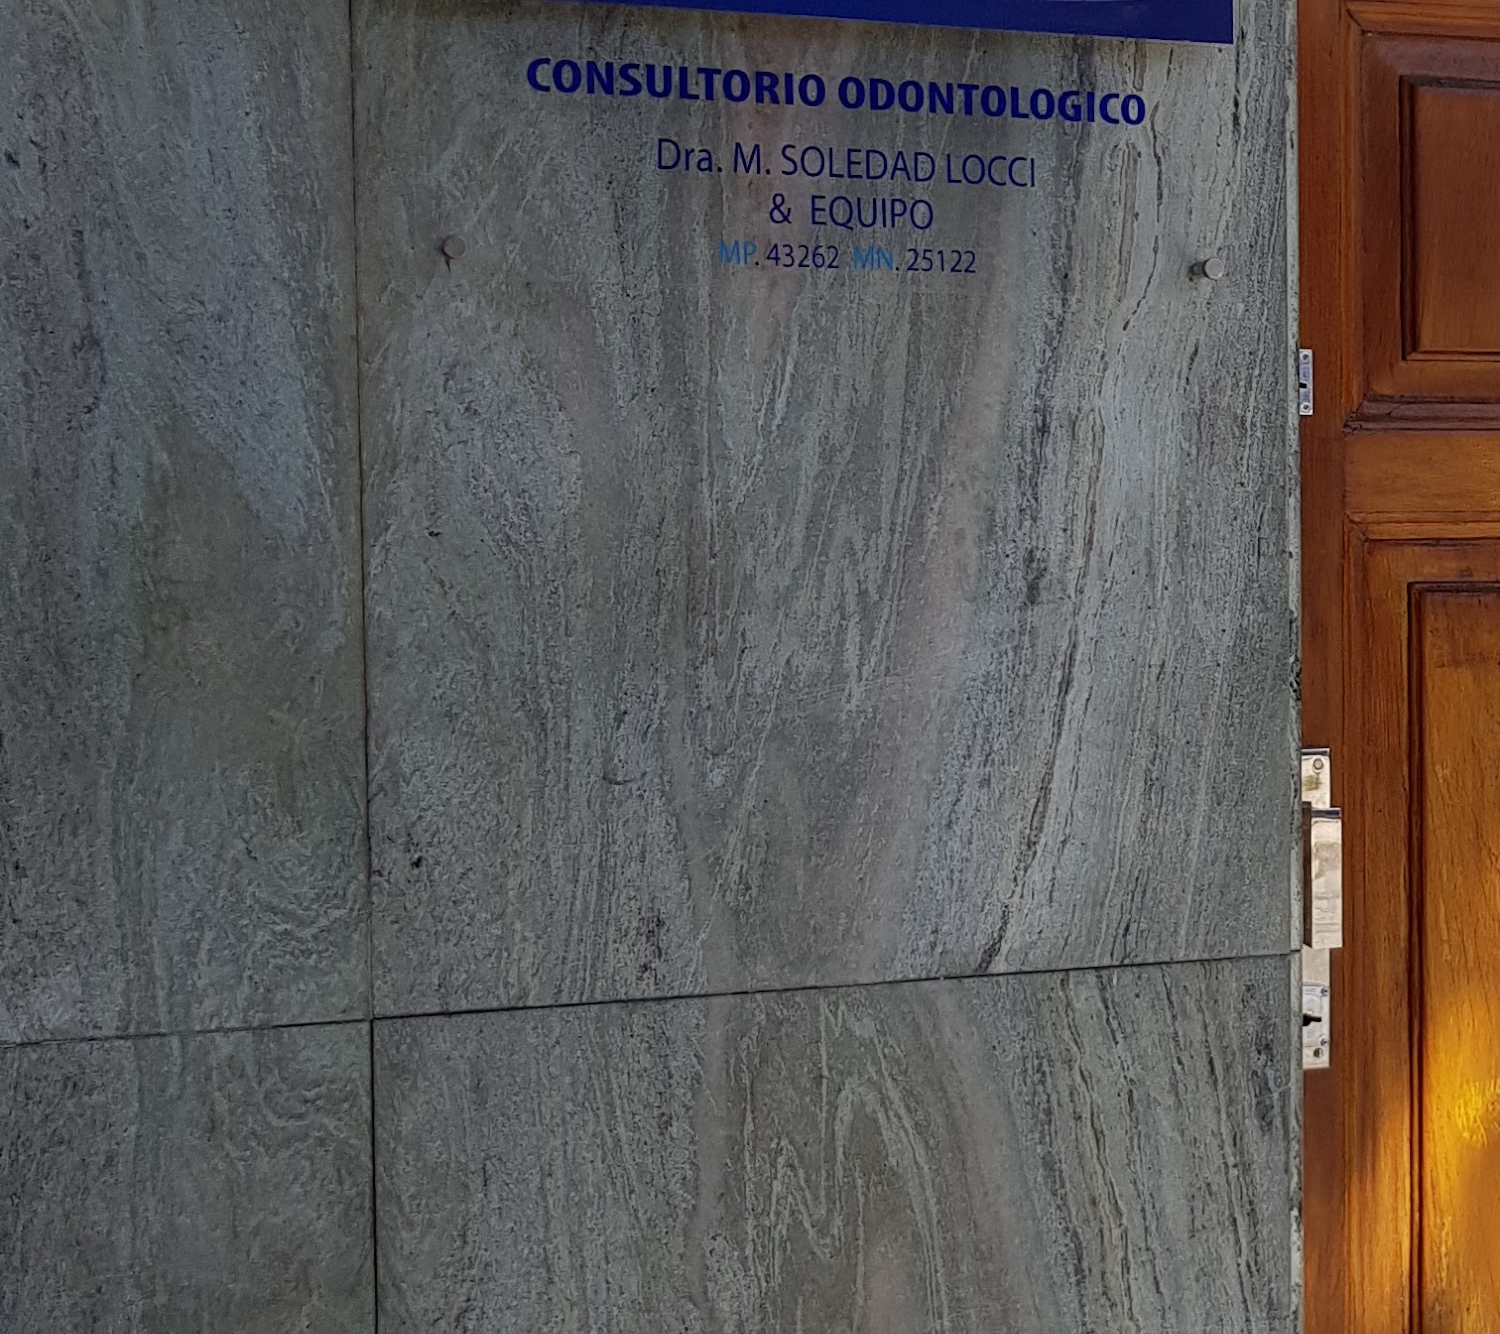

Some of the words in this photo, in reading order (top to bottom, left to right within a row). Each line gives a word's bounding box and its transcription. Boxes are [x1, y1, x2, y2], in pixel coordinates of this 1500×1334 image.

[526, 57, 827, 107] CONSULTORIO
[837, 76, 1147, 126] ODONTOLOGICO
[656, 137, 724, 174] Dra.
[733, 141, 771, 175] M.
[780, 143, 937, 183] SOLEDAD
[945, 152, 1037, 188] LOCCI
[769, 192, 792, 224] &
[810, 194, 935, 231] EQUIPO
[718, 239, 760, 267] MP.
[765, 242, 840, 269] 43262
[852, 245, 900, 273] MN.
[906, 248, 976, 274] 25122
